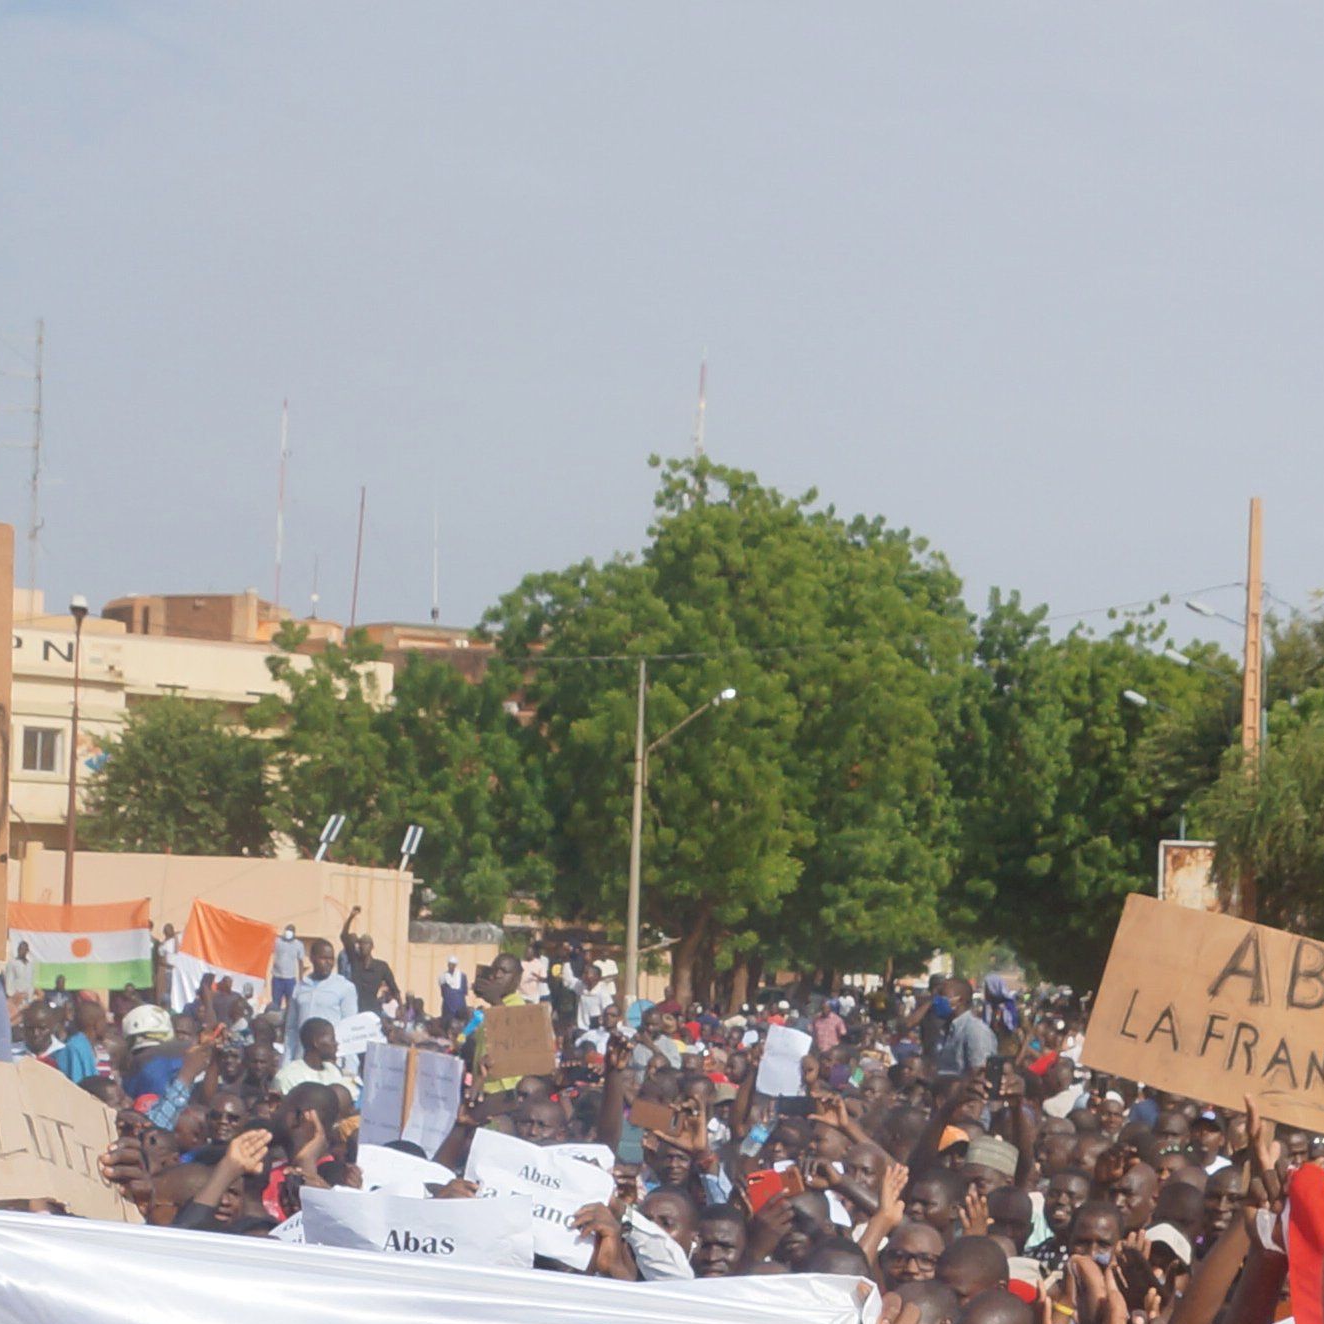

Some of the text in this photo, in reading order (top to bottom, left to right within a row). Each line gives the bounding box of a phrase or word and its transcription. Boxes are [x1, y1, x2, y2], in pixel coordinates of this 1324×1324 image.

[1119, 988, 1180, 1053] LA
[517, 1164, 562, 1190] Abas
[383, 1229, 456, 1255] Abas
